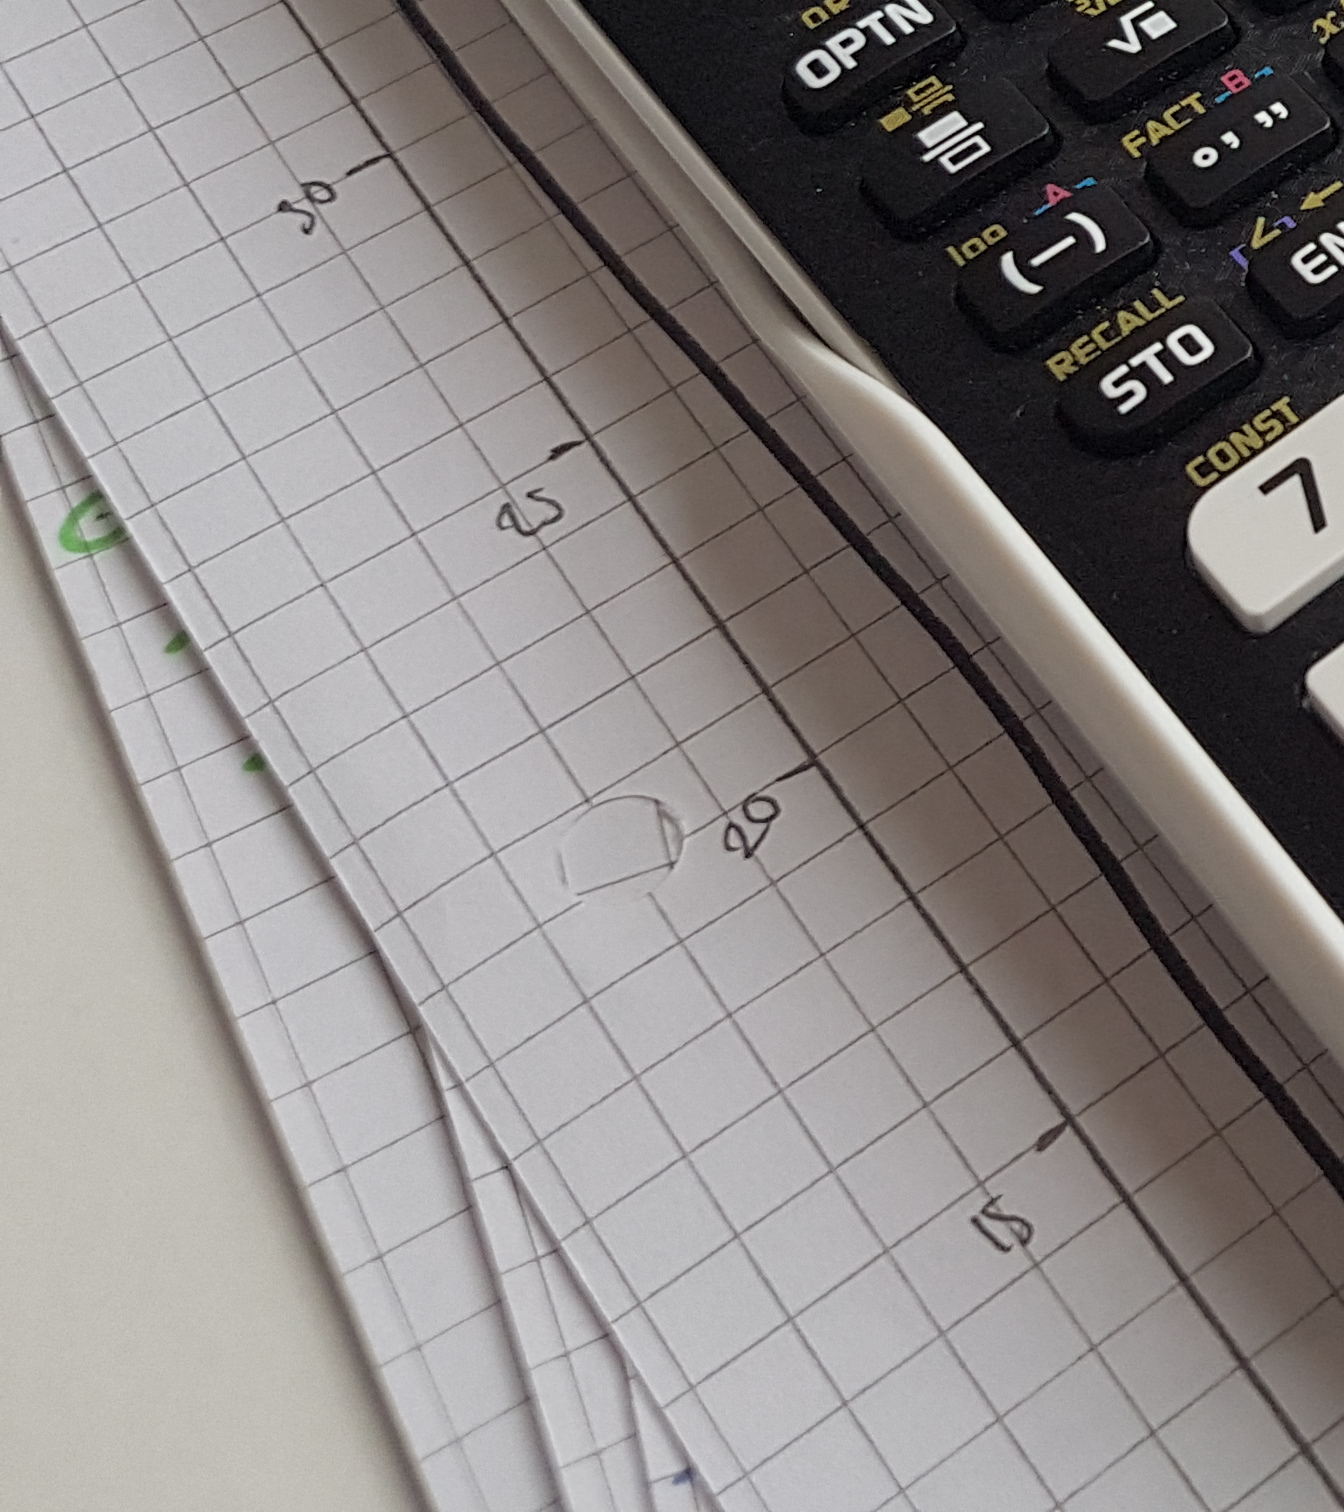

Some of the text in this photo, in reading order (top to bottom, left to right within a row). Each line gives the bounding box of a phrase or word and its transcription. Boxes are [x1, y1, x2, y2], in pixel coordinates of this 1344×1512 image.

[1121, 91, 1208, 159] FACT
[1044, 285, 1187, 382] RECALL
[1098, 322, 1217, 416] STO
[1185, 395, 1302, 487] CONST
[1257, 456, 1328, 535] 7
[722, 792, 781, 859] 20
